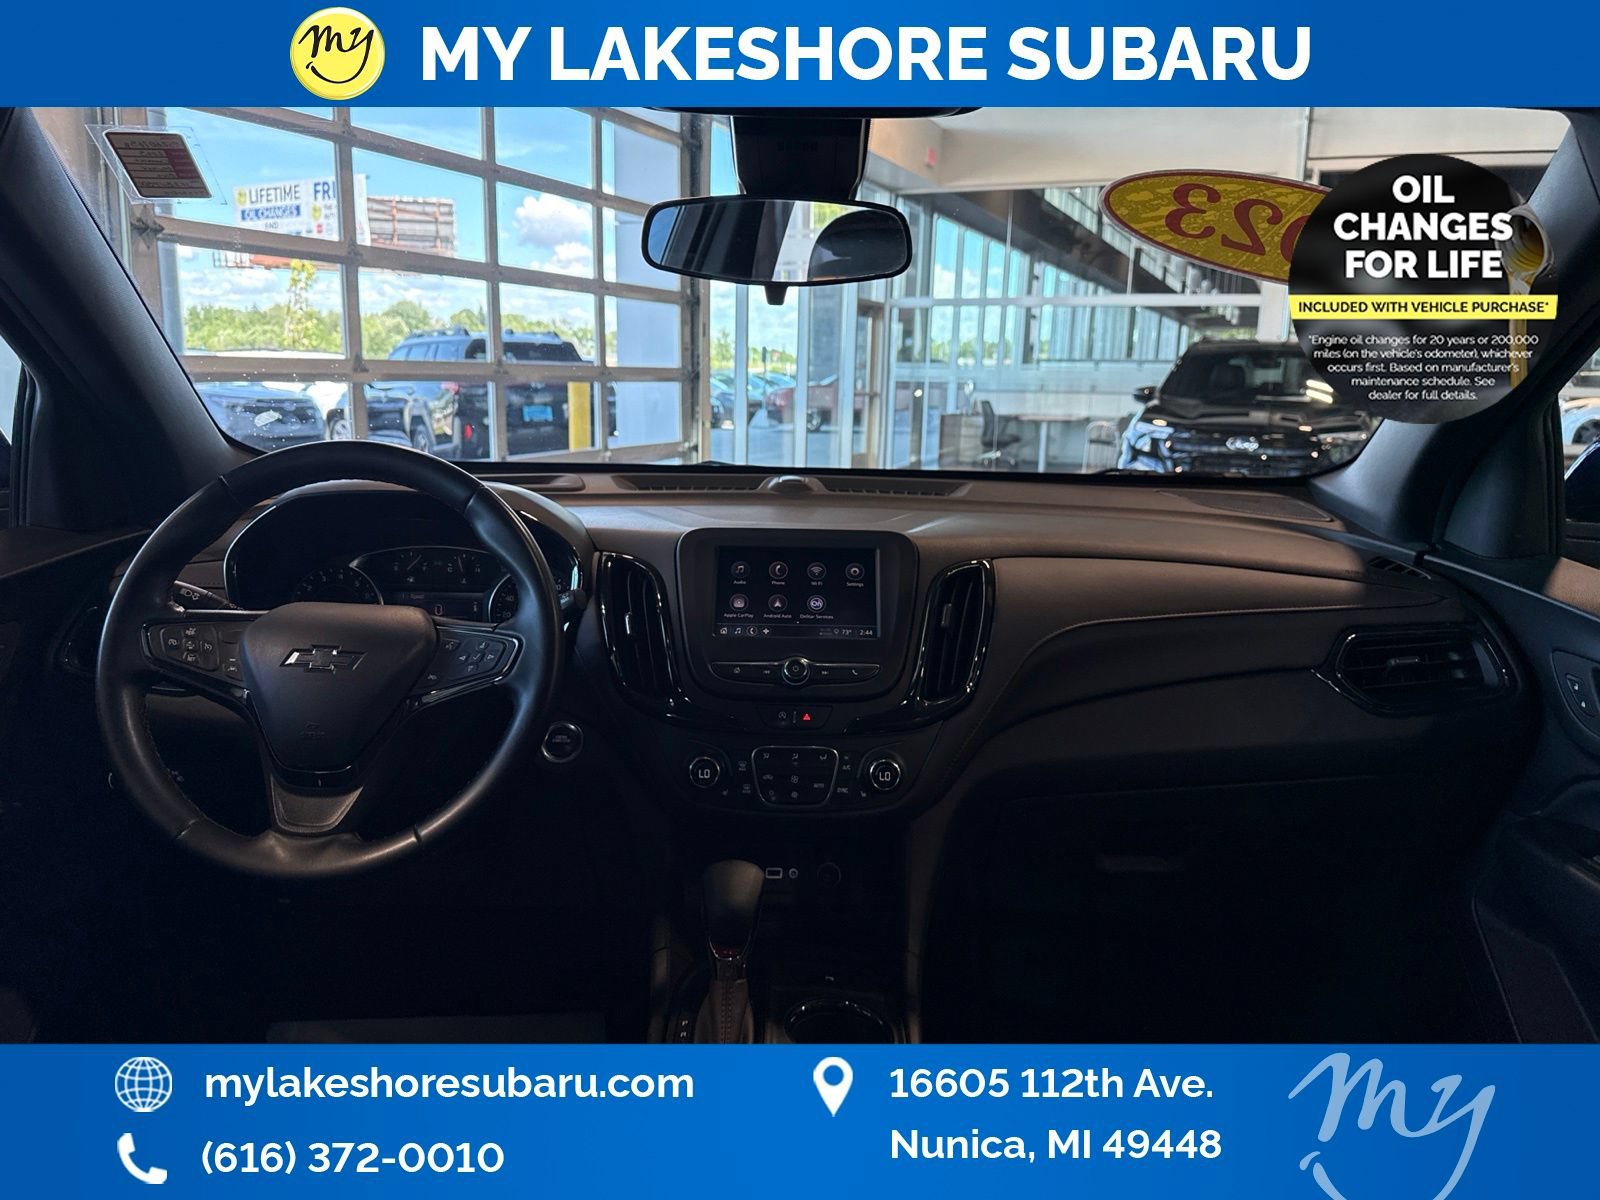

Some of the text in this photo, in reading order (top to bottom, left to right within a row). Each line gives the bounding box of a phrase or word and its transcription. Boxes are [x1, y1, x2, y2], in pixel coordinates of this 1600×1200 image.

[248, 184, 301, 204] LIFETIME
[698, 768, 711, 779] LO
[878, 770, 891, 781] LO
